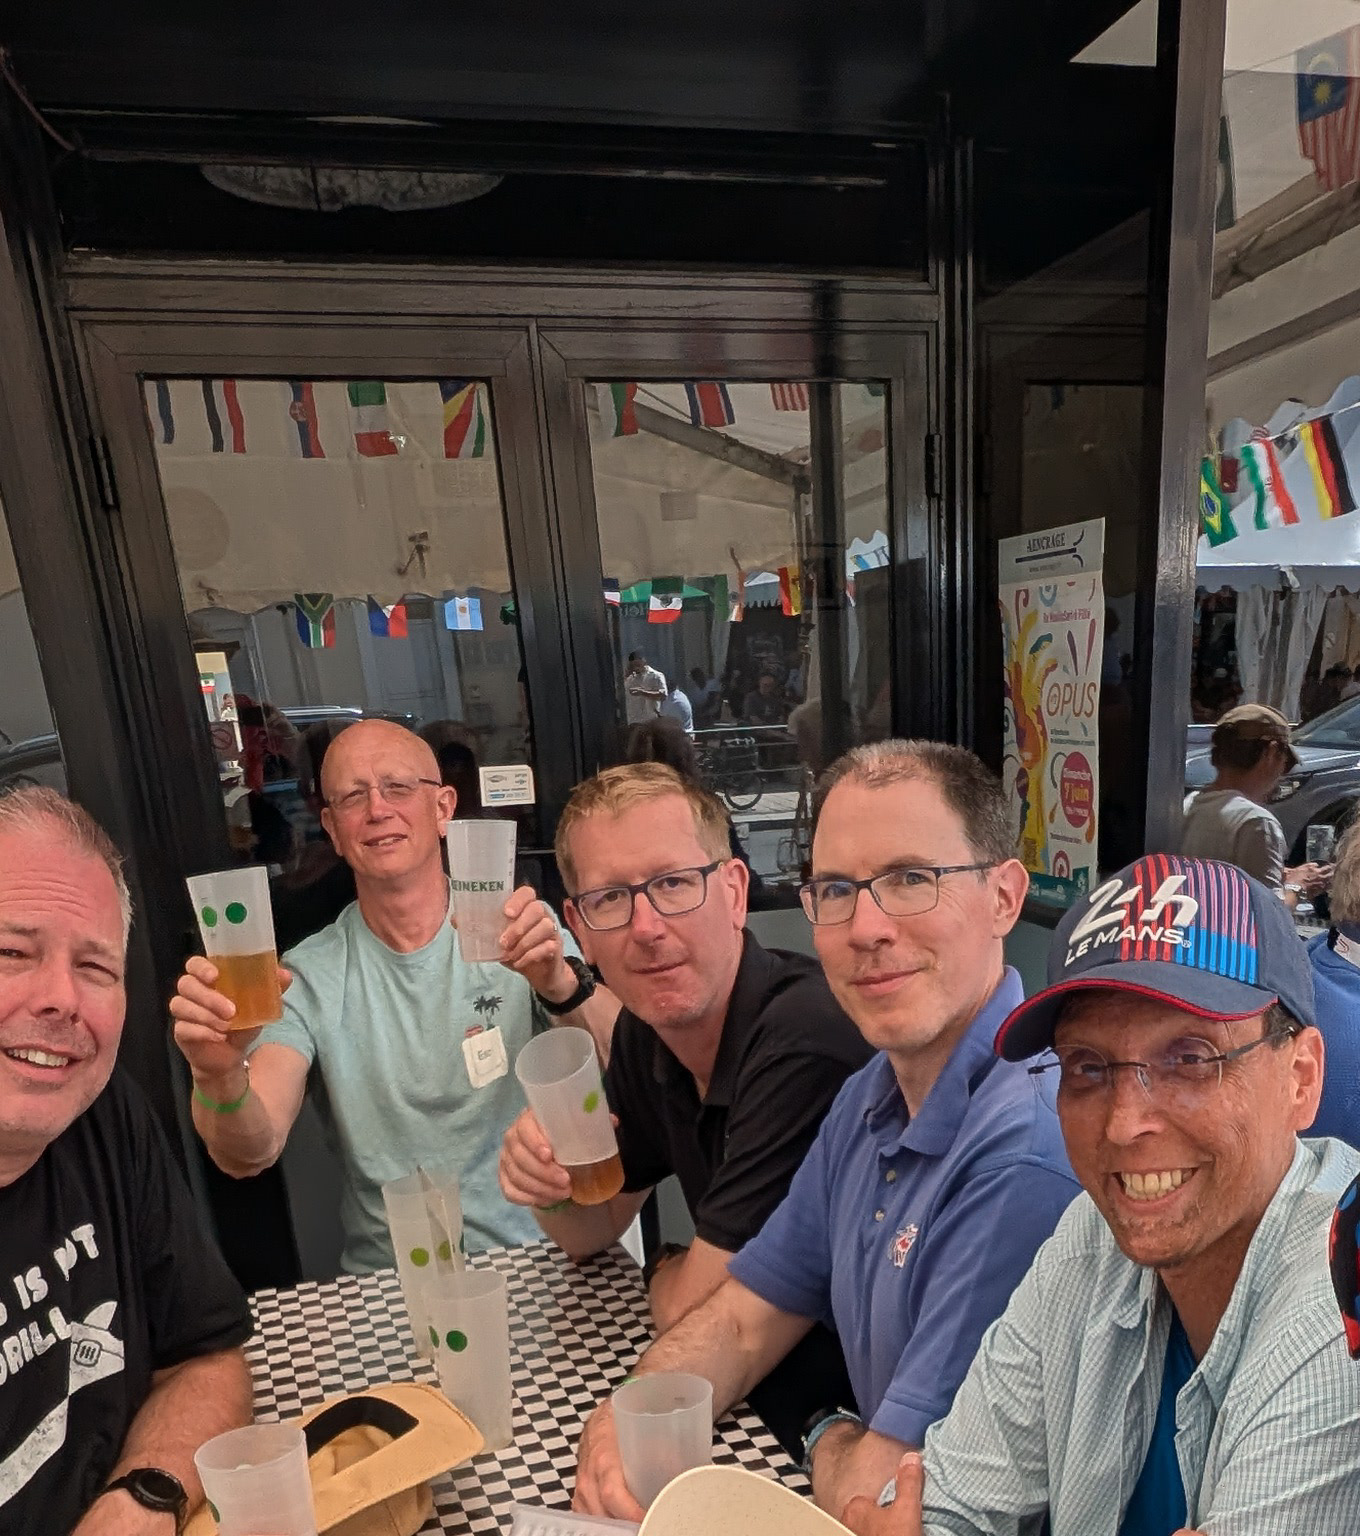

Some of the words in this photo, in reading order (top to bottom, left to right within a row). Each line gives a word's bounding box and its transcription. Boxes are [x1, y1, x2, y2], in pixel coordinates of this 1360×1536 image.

[1046, 682, 1097, 717] OPUS
[451, 880, 505, 892] EINEKEN
[1064, 936, 1093, 967] LE
[1095, 926, 1185, 945] MANS
[13, 1266, 49, 1310] IS
